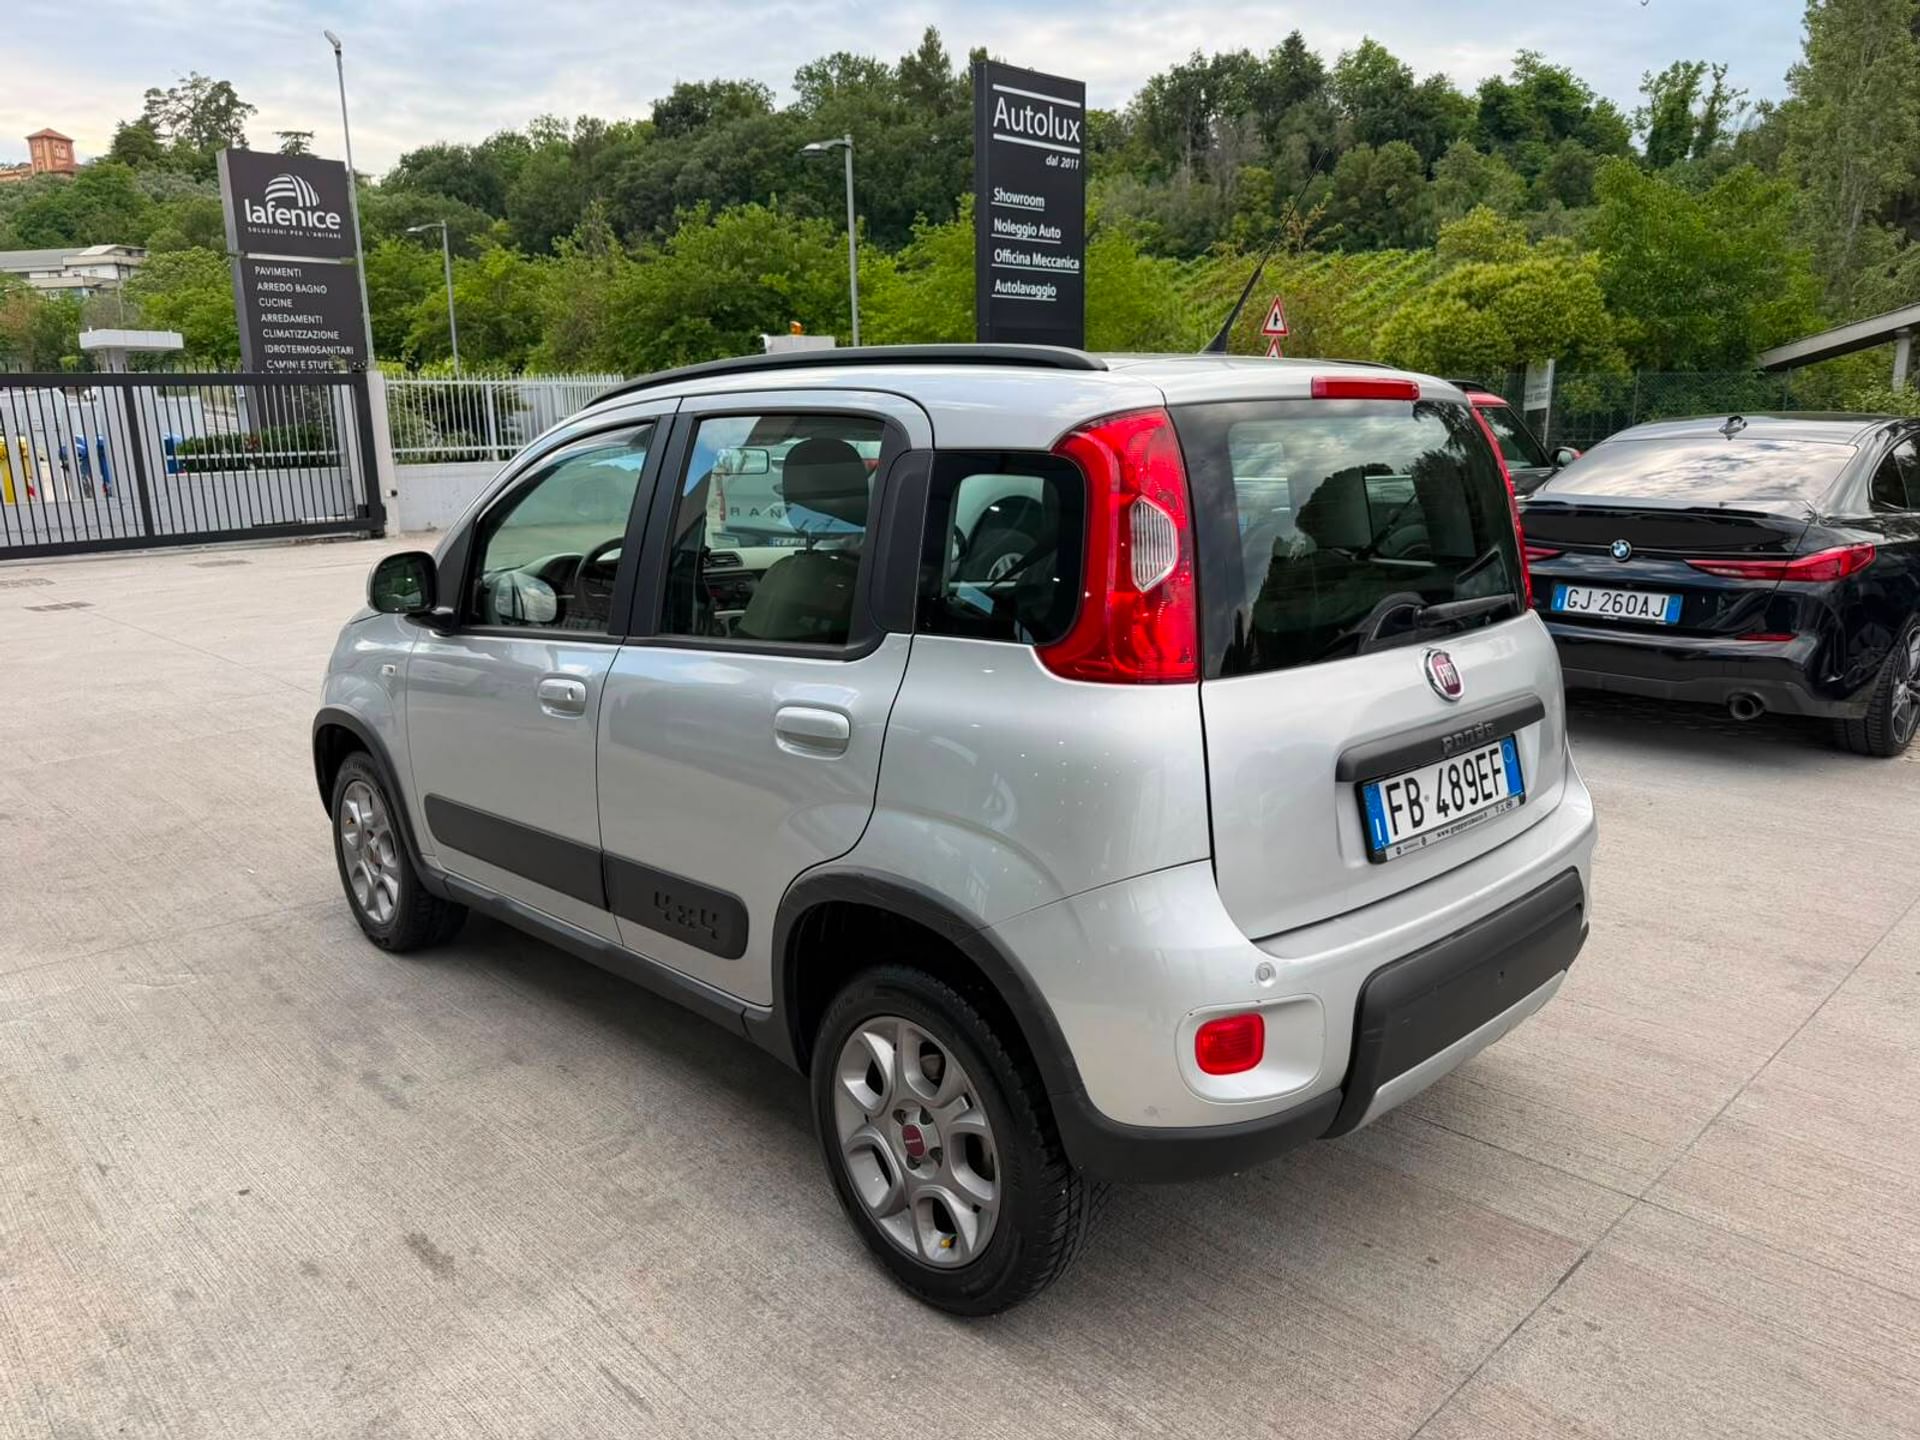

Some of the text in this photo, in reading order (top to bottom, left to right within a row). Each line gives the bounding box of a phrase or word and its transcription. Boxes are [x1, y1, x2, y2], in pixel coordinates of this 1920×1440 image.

[993, 97, 1080, 143] Autolux
[1045, 155, 1080, 170] dal 2011
[993, 187, 1045, 207] Showroom
[994, 218, 1061, 239] Noleggio Auto
[994, 249, 1080, 269] Officina Meccanica
[254, 266, 301, 278] PAVIMENTI
[256, 282, 328, 294] ARREDO BAGNO
[994, 279, 1057, 298] Autolavaggio
[258, 297, 293, 308] CUCINE
[260, 313, 323, 325] ARREDAMENTI
[262, 329, 340, 340] CLIMATIZZAZIONE
[264, 344, 354, 355] IDROTERMOSANITARI
[300, 360, 306, 369] E
[1567, 589, 1595, 610] GJ
[1598, 591, 1666, 617] 260AJ
[1386, 777, 1425, 835] FB
[1436, 747, 1503, 818] 489EF
